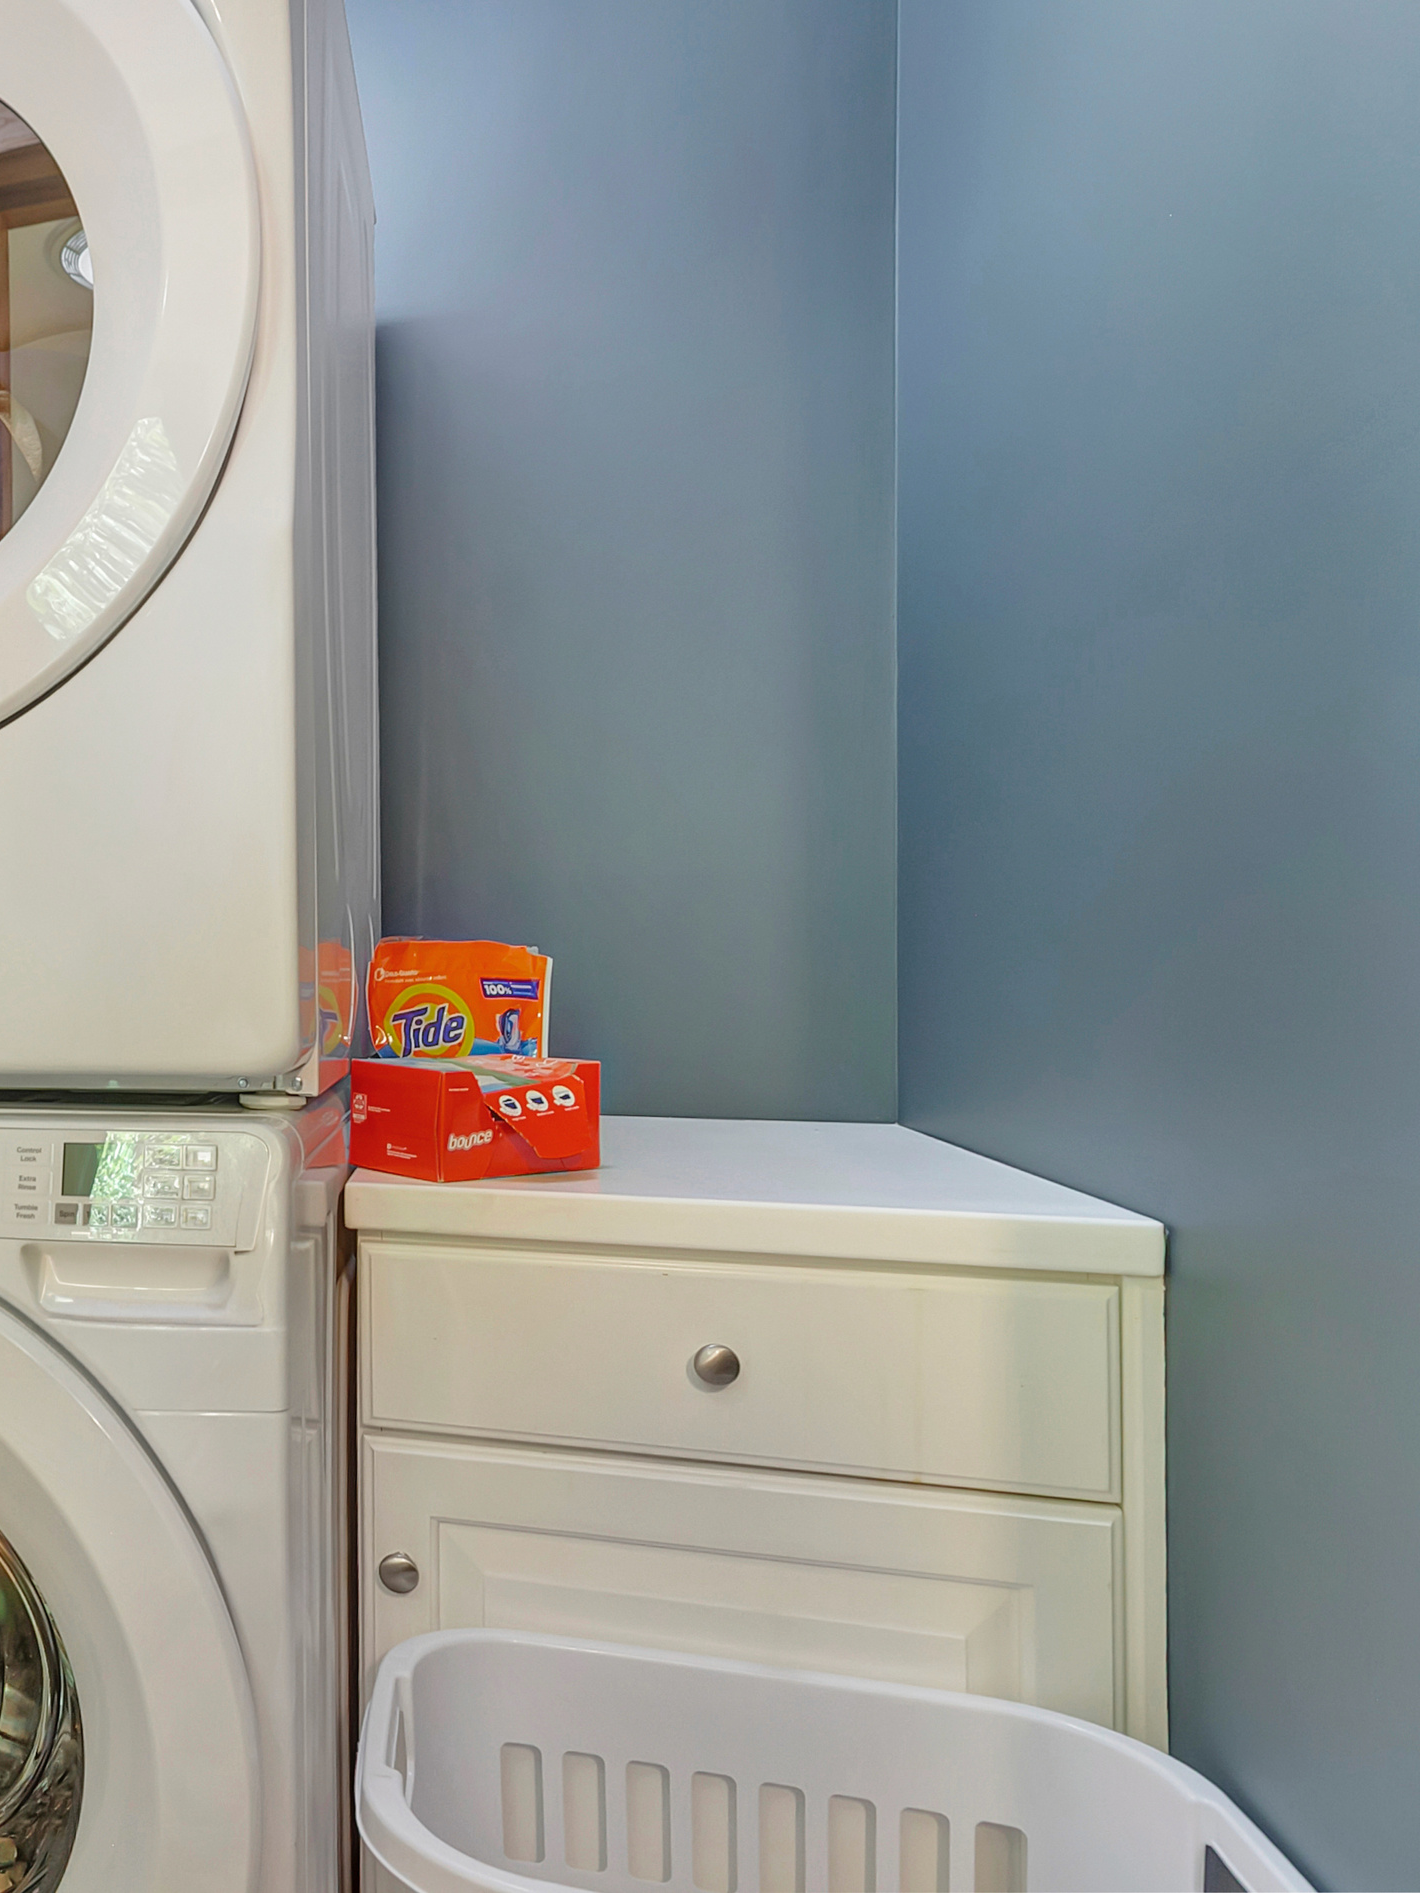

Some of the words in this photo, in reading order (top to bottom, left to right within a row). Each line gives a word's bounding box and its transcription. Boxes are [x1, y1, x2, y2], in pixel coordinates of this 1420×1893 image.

[484, 984, 512, 995] 100%
[391, 1003, 467, 1057] Tide
[447, 1129, 493, 1151] bounce
[59, 1210, 75, 1218] Spin
